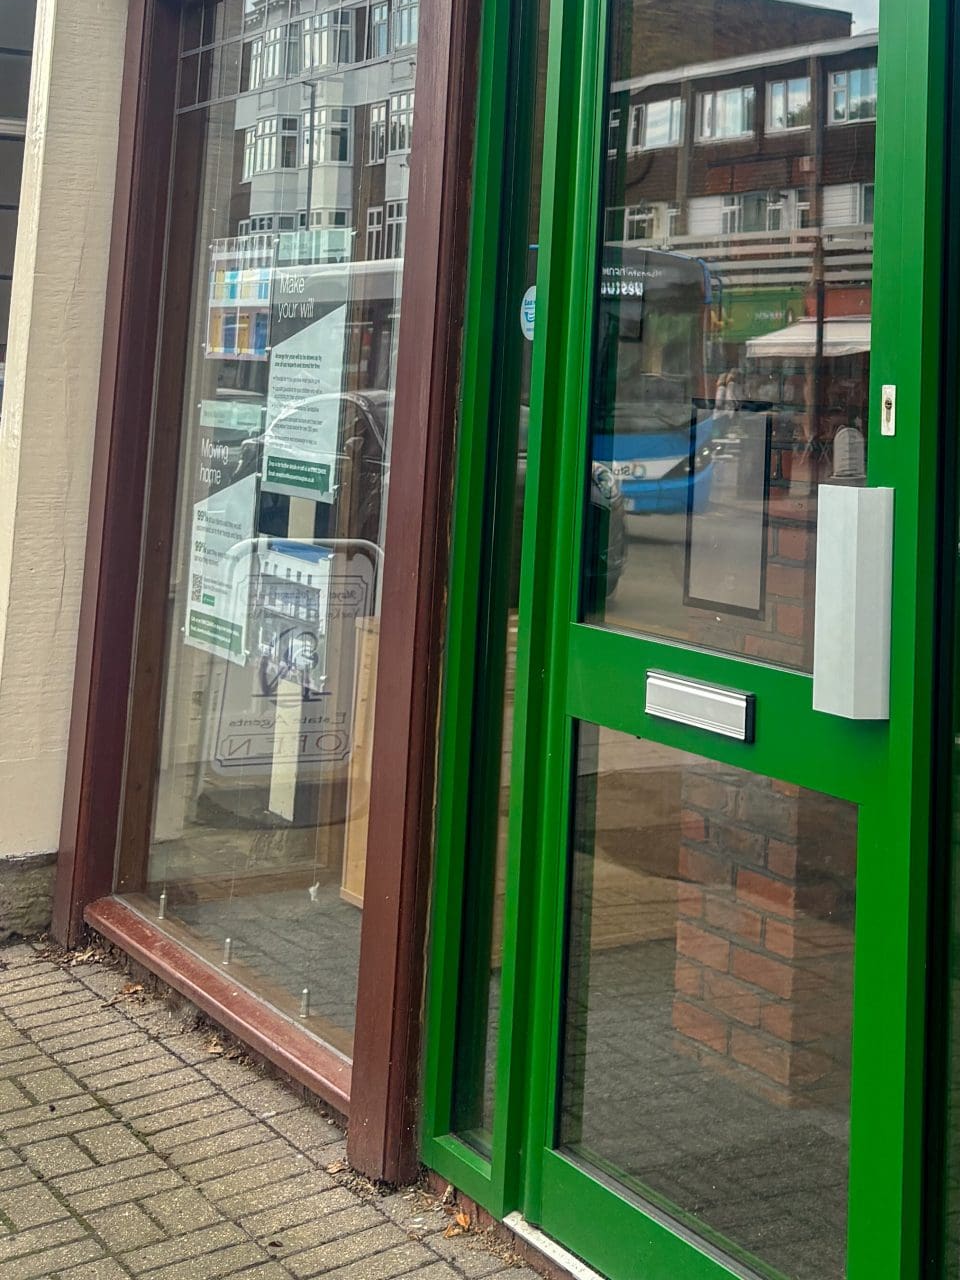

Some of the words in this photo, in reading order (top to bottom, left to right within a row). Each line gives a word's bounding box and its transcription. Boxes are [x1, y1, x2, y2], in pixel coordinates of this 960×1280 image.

[280, 273, 304, 293] Make
[278, 301, 297, 322] your
[300, 297, 314, 318] will
[201, 438, 228, 465] Moving
[200, 462, 221, 484] home
